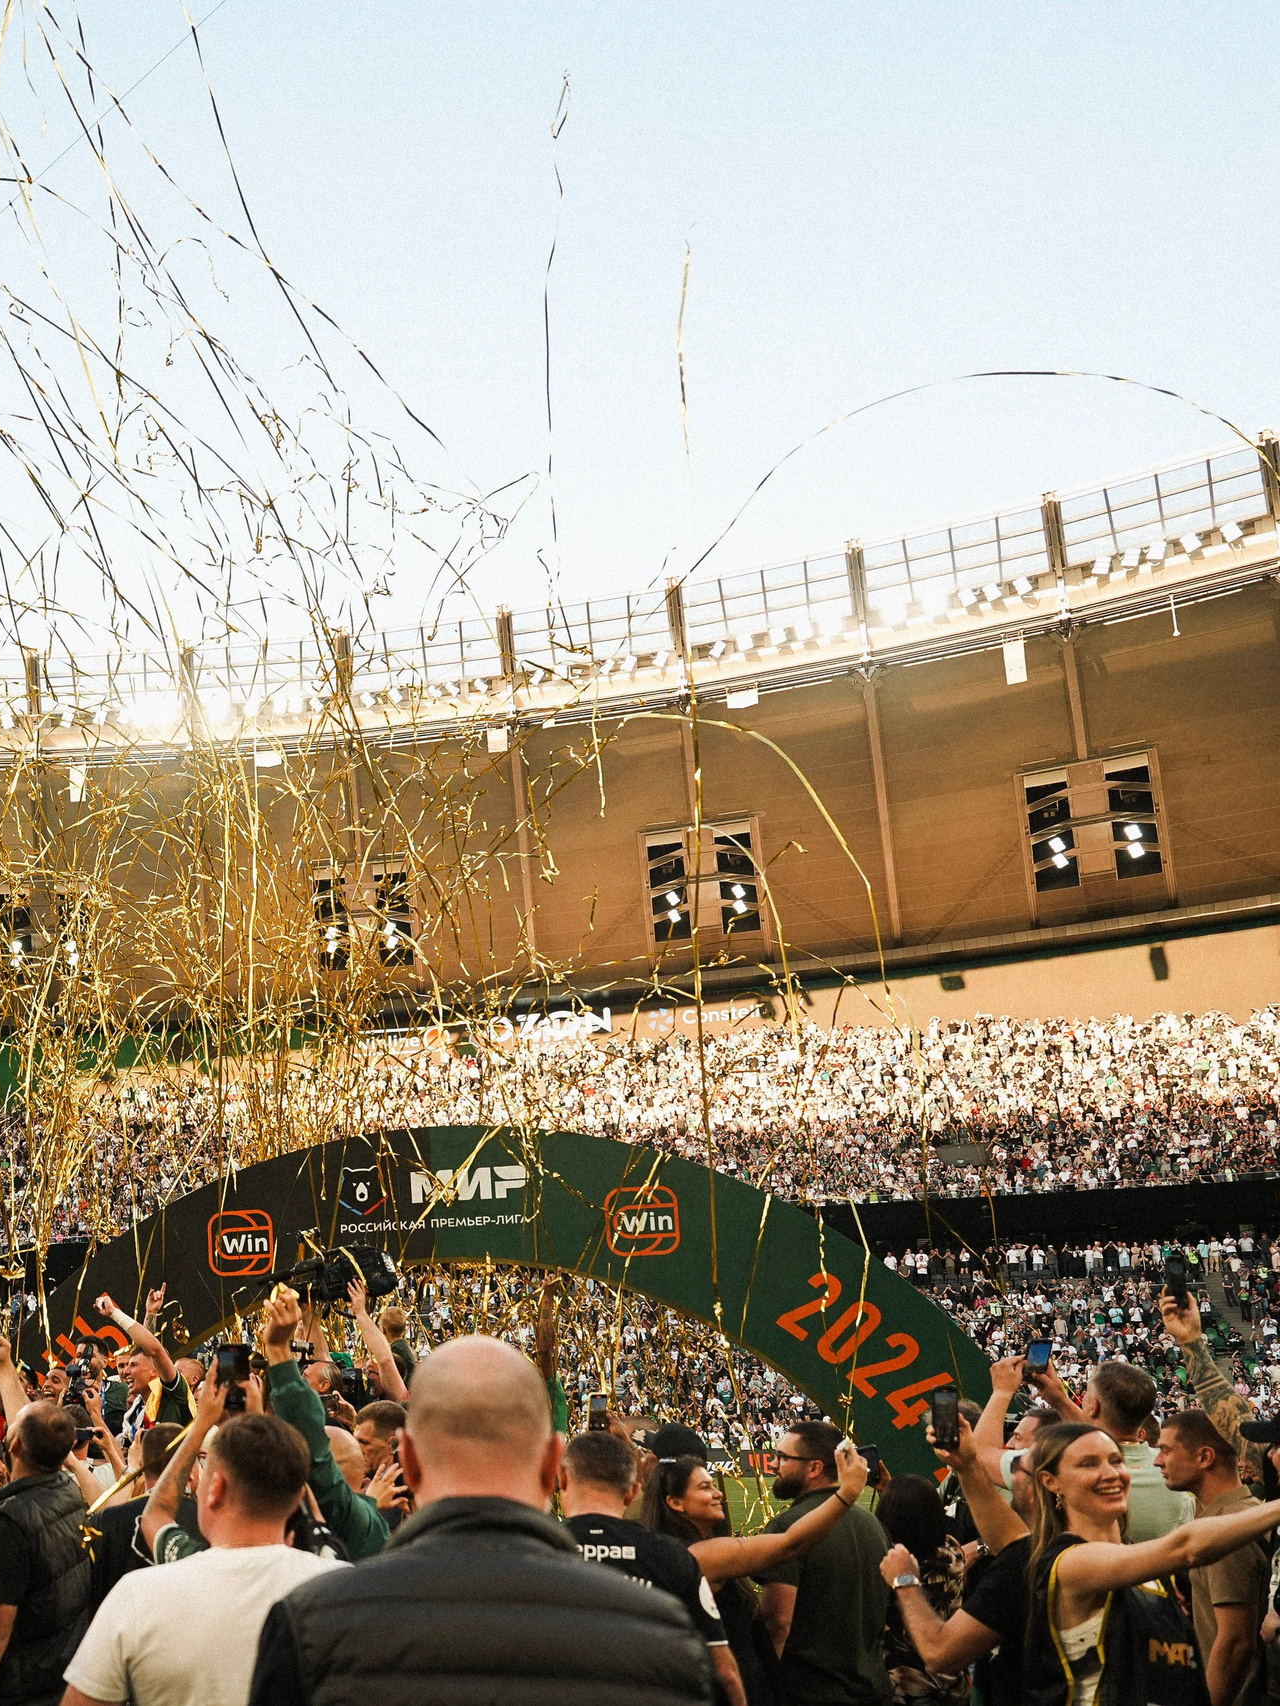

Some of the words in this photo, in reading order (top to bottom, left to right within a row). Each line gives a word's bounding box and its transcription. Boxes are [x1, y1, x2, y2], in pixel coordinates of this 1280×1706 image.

[409, 1165, 527, 1204] МИР
[340, 1219, 426, 1234] РОССИЙСКАЯ
[430, 1214, 529, 1229] ПРЕМЬЕР-ЛИГА
[622, 1211, 673, 1233] Win
[222, 1233, 269, 1254] Win
